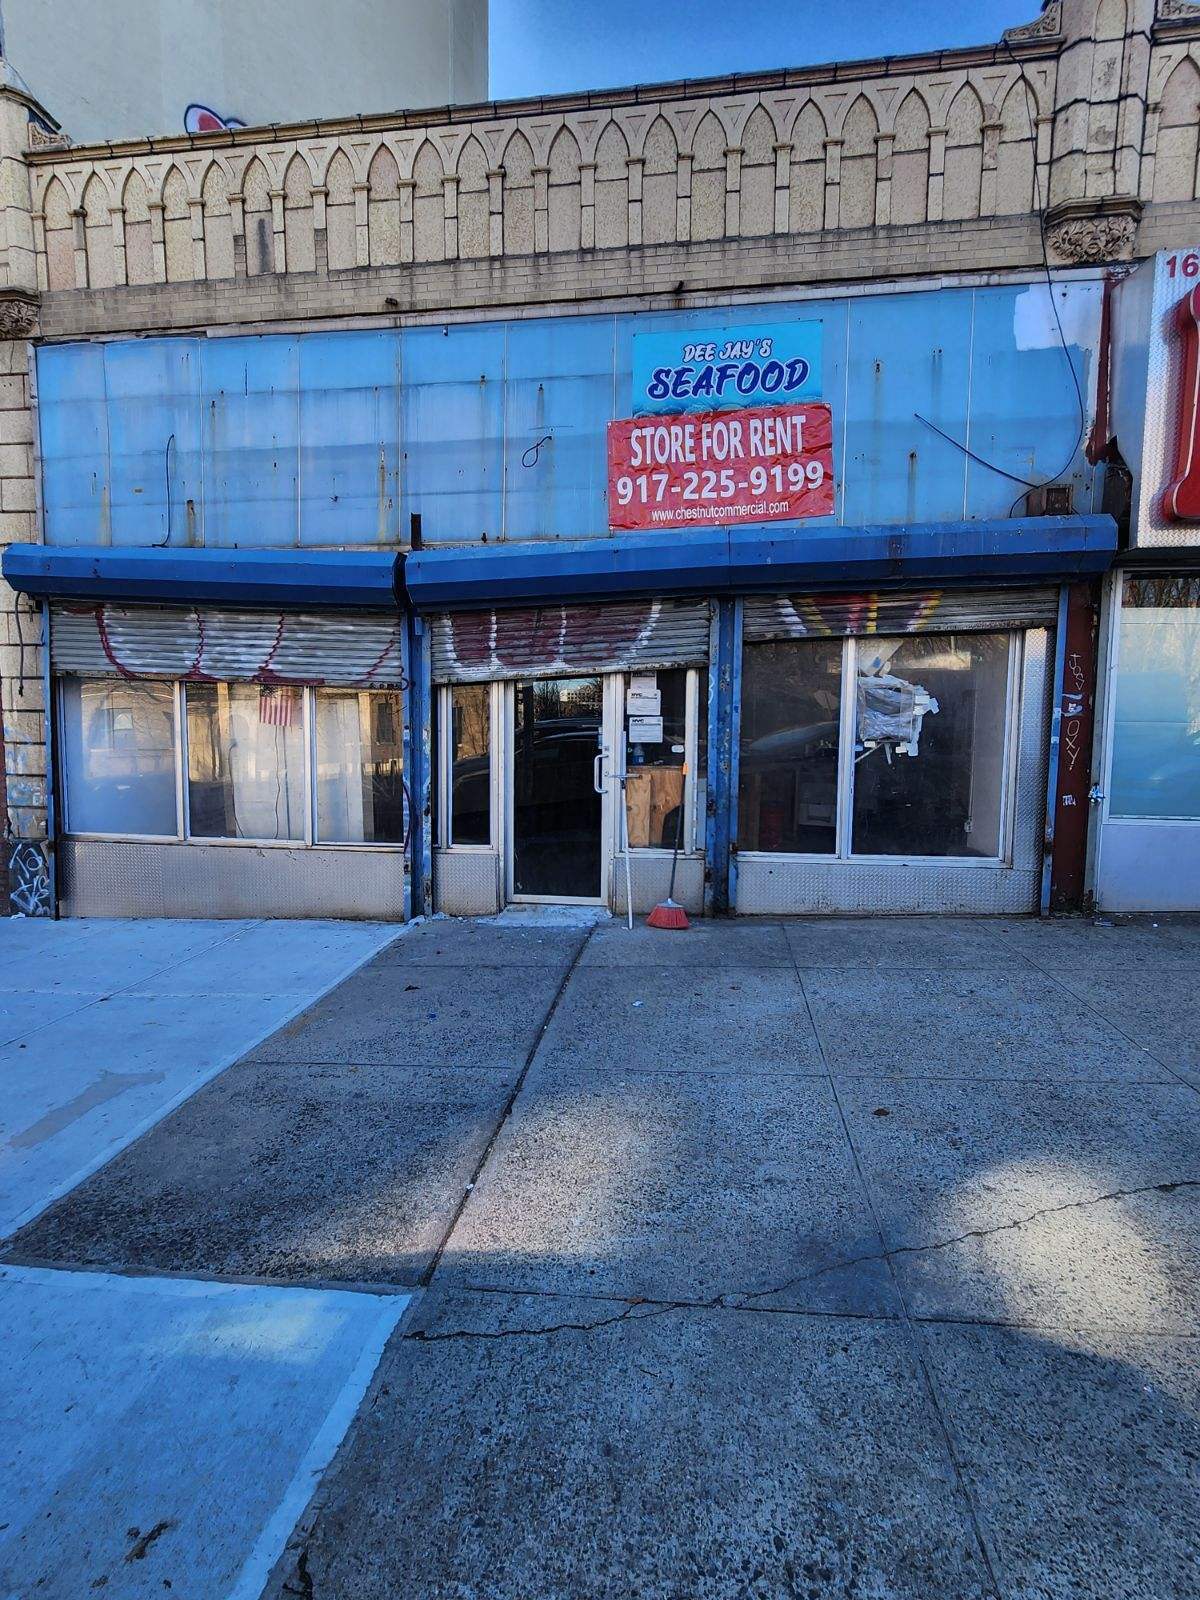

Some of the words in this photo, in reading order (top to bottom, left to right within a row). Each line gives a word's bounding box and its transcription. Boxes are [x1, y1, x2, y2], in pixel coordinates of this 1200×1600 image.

[683, 343, 715, 362] DEE
[720, 338, 772, 360] JAY'S
[647, 358, 809, 400] SEAFOOD
[630, 424, 696, 467] STORE
[701, 420, 745, 461] FOR
[750, 415, 806, 457] RENT
[616, 460, 824, 505] 917-225-9199
[651, 500, 789, 521] www.chestnutcommercial.com
